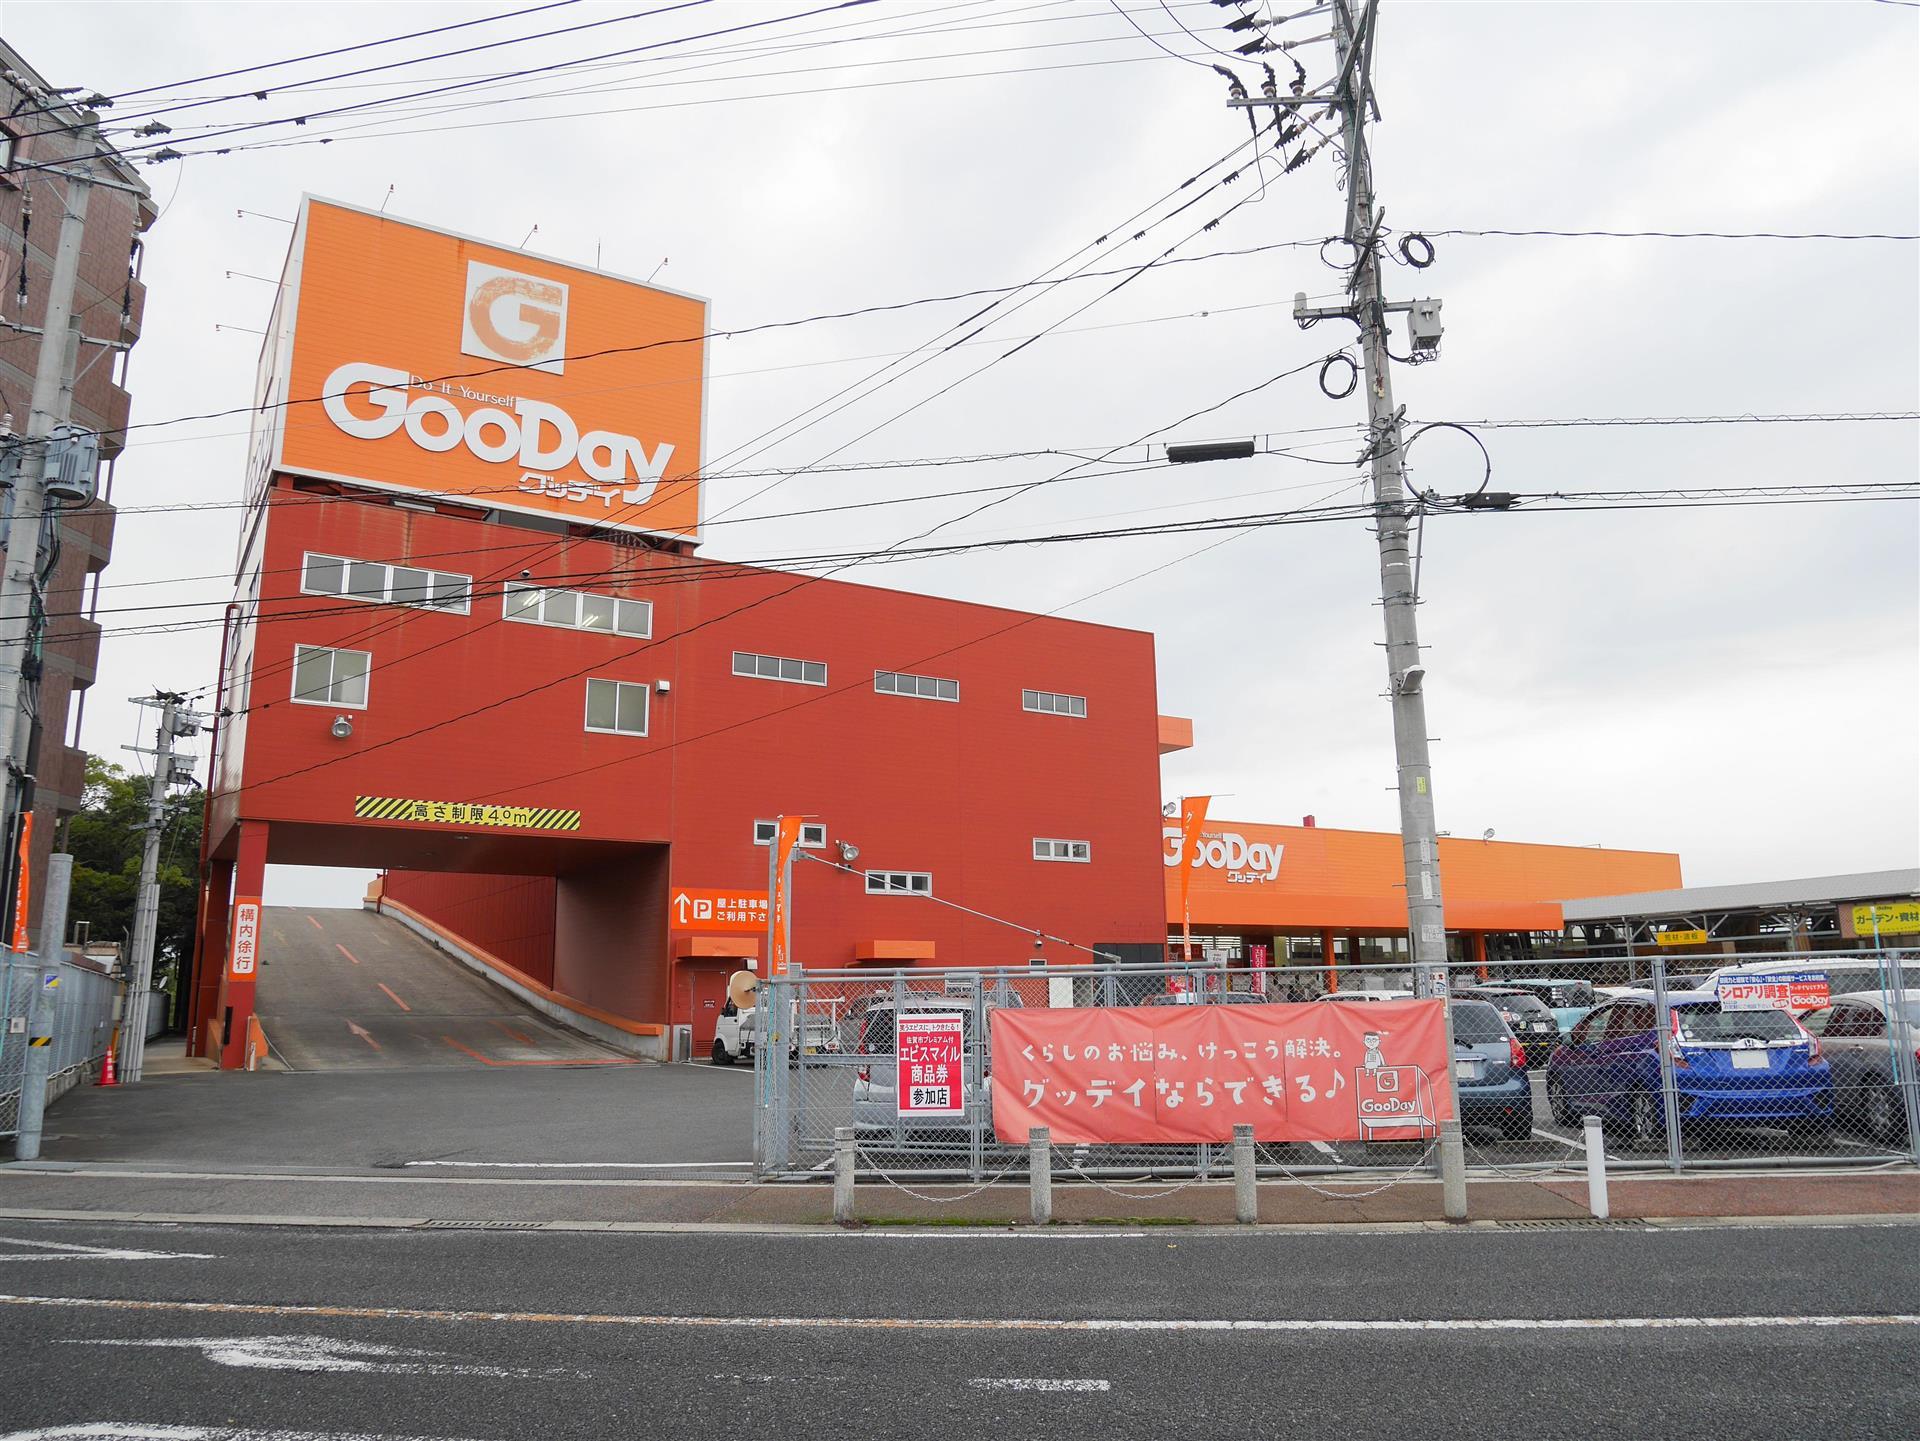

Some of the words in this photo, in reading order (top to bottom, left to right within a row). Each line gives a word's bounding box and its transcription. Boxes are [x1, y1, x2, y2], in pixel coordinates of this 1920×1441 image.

[411, 375, 433, 390] Do
[442, 381, 451, 394] It
[460, 385, 516, 407] Yourself
[322, 362, 675, 505] GooDay
[717, 898, 768, 910] 屋上駐車場
[236, 908, 255, 970] 構内徐行
[1721, 984, 1790, 999] シロアリ調査
[1791, 995, 1828, 1006] GooDay
[900, 1045, 961, 1062] エビスマイル
[911, 1064, 948, 1083] 商品券
[913, 1088, 947, 1105] 参加店
[1361, 1097, 1416, 1113] GooDay
